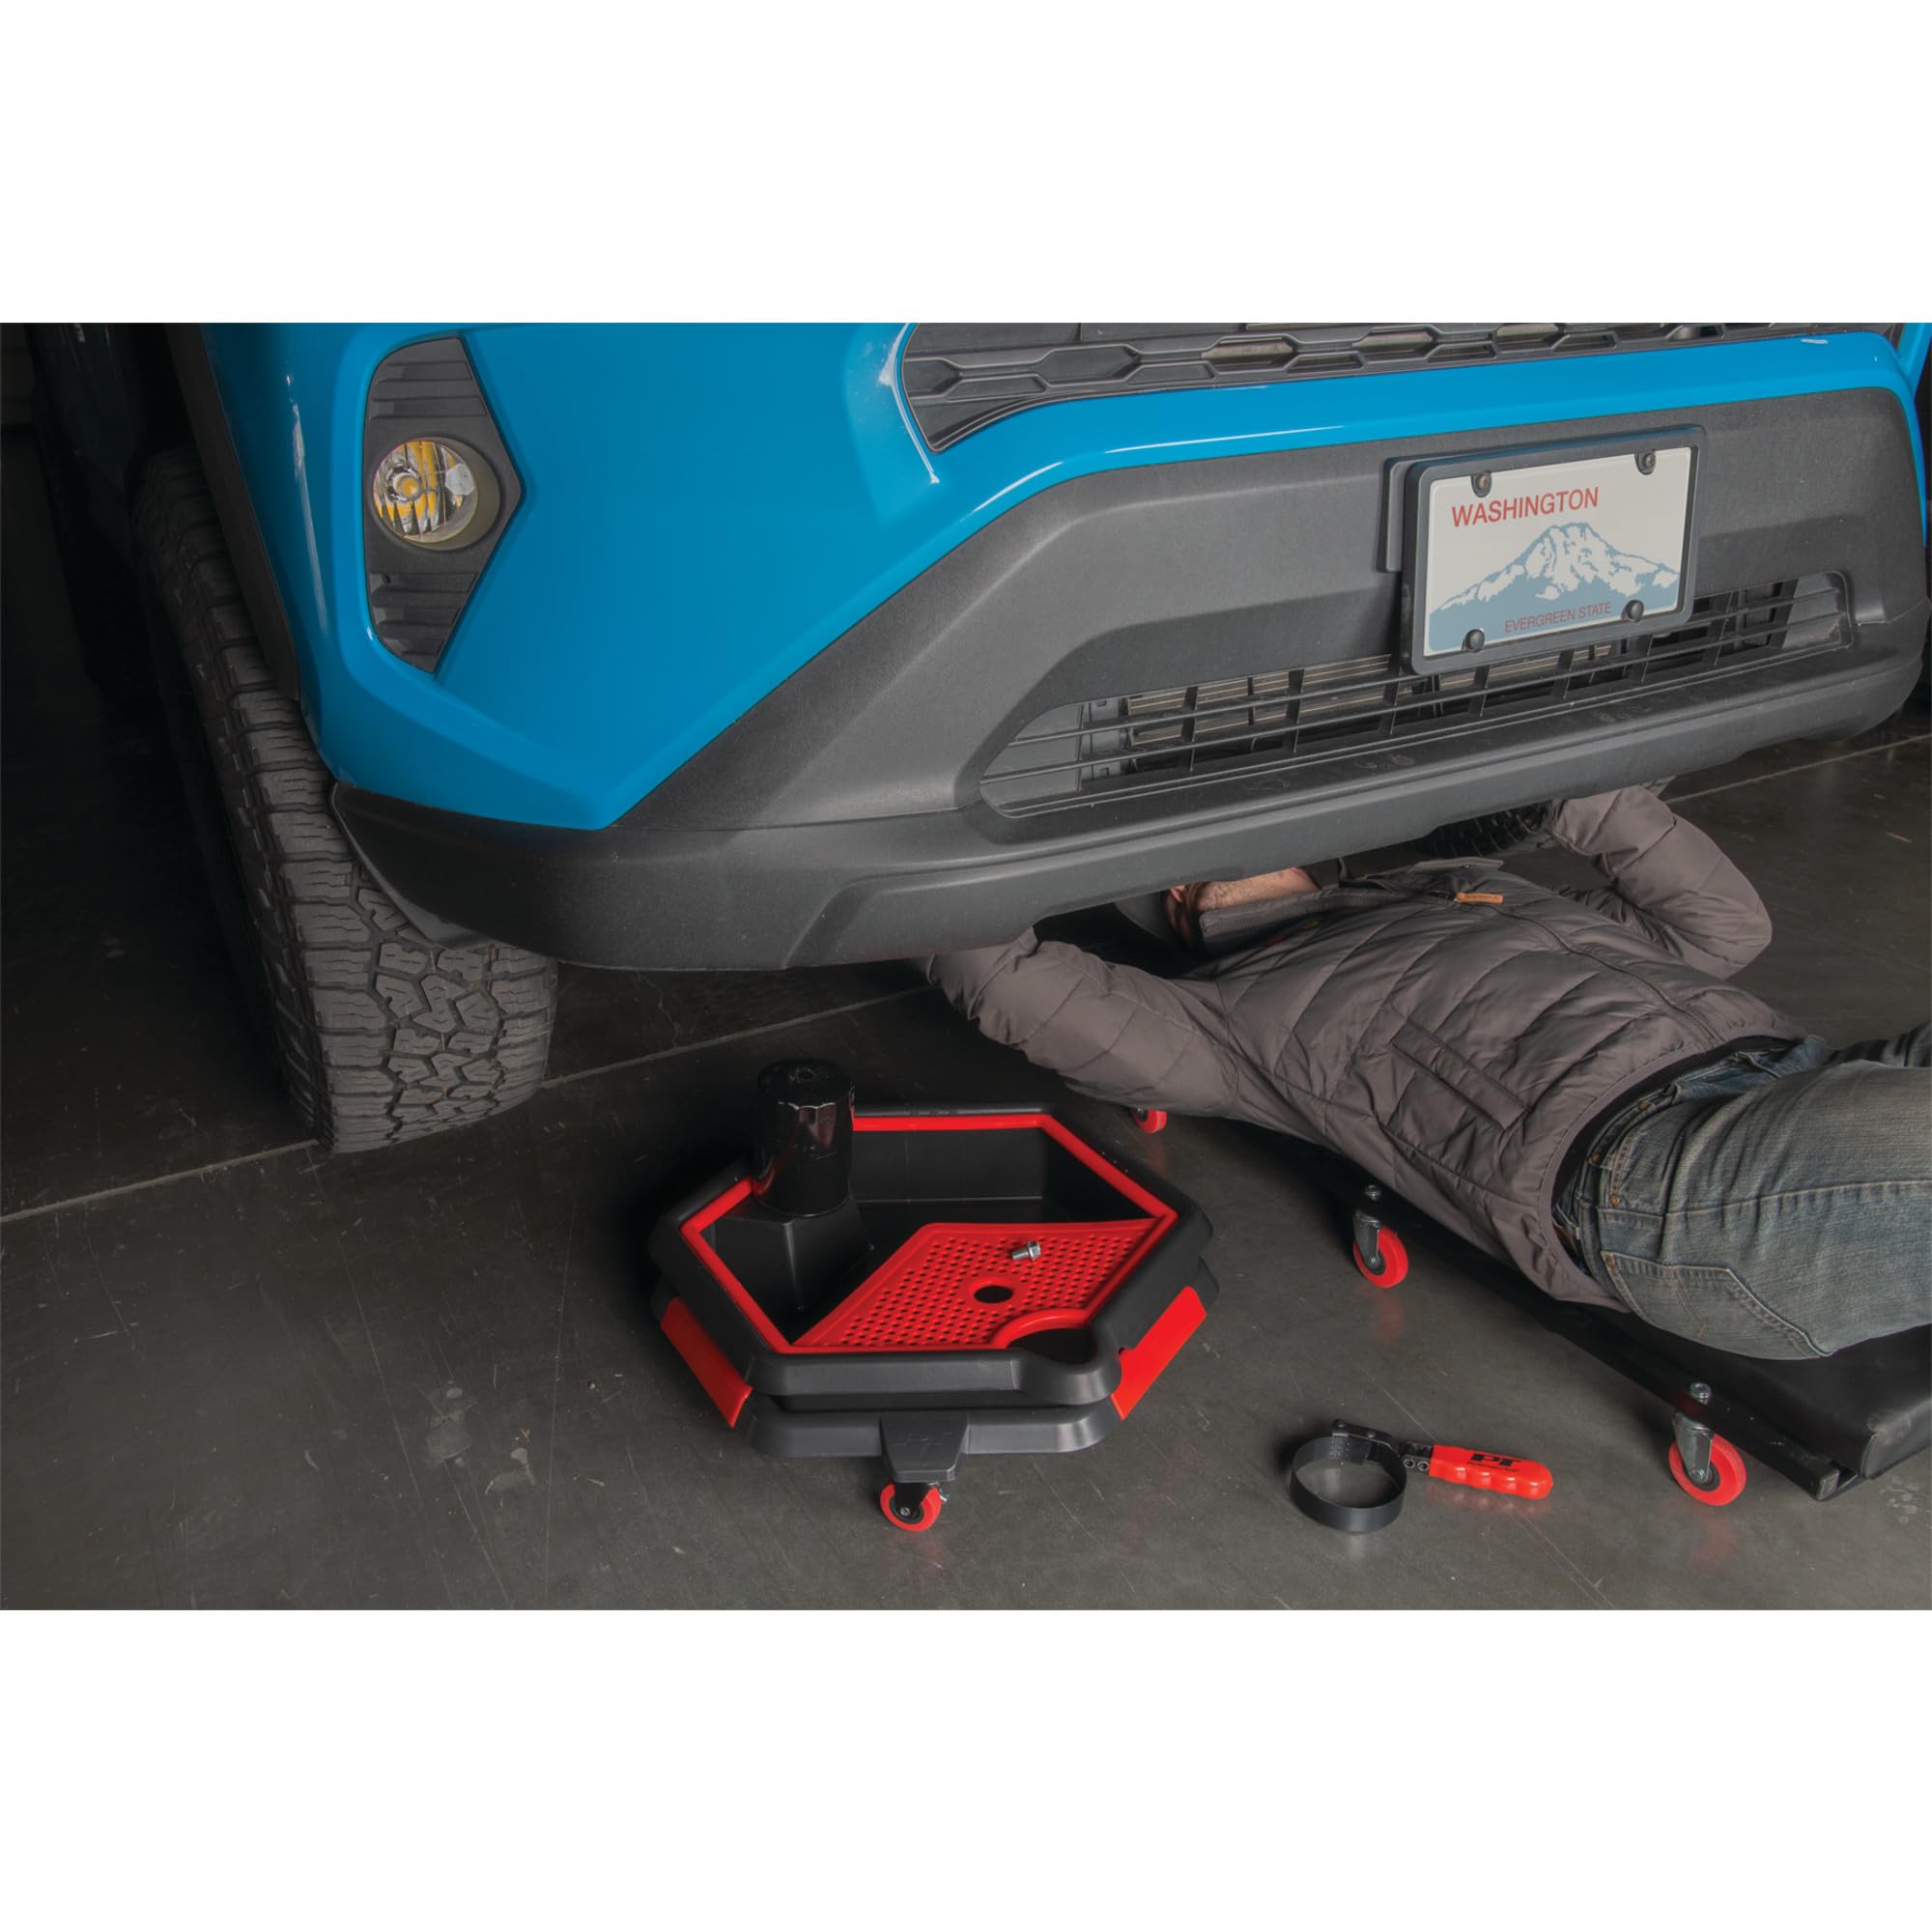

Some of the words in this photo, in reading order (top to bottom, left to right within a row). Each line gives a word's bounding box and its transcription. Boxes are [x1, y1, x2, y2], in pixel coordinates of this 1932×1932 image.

[1452, 487, 1599, 527] WASHINGTON
[1505, 609, 1576, 634] EVERGREEN
[1578, 602, 1612, 619] STATE
